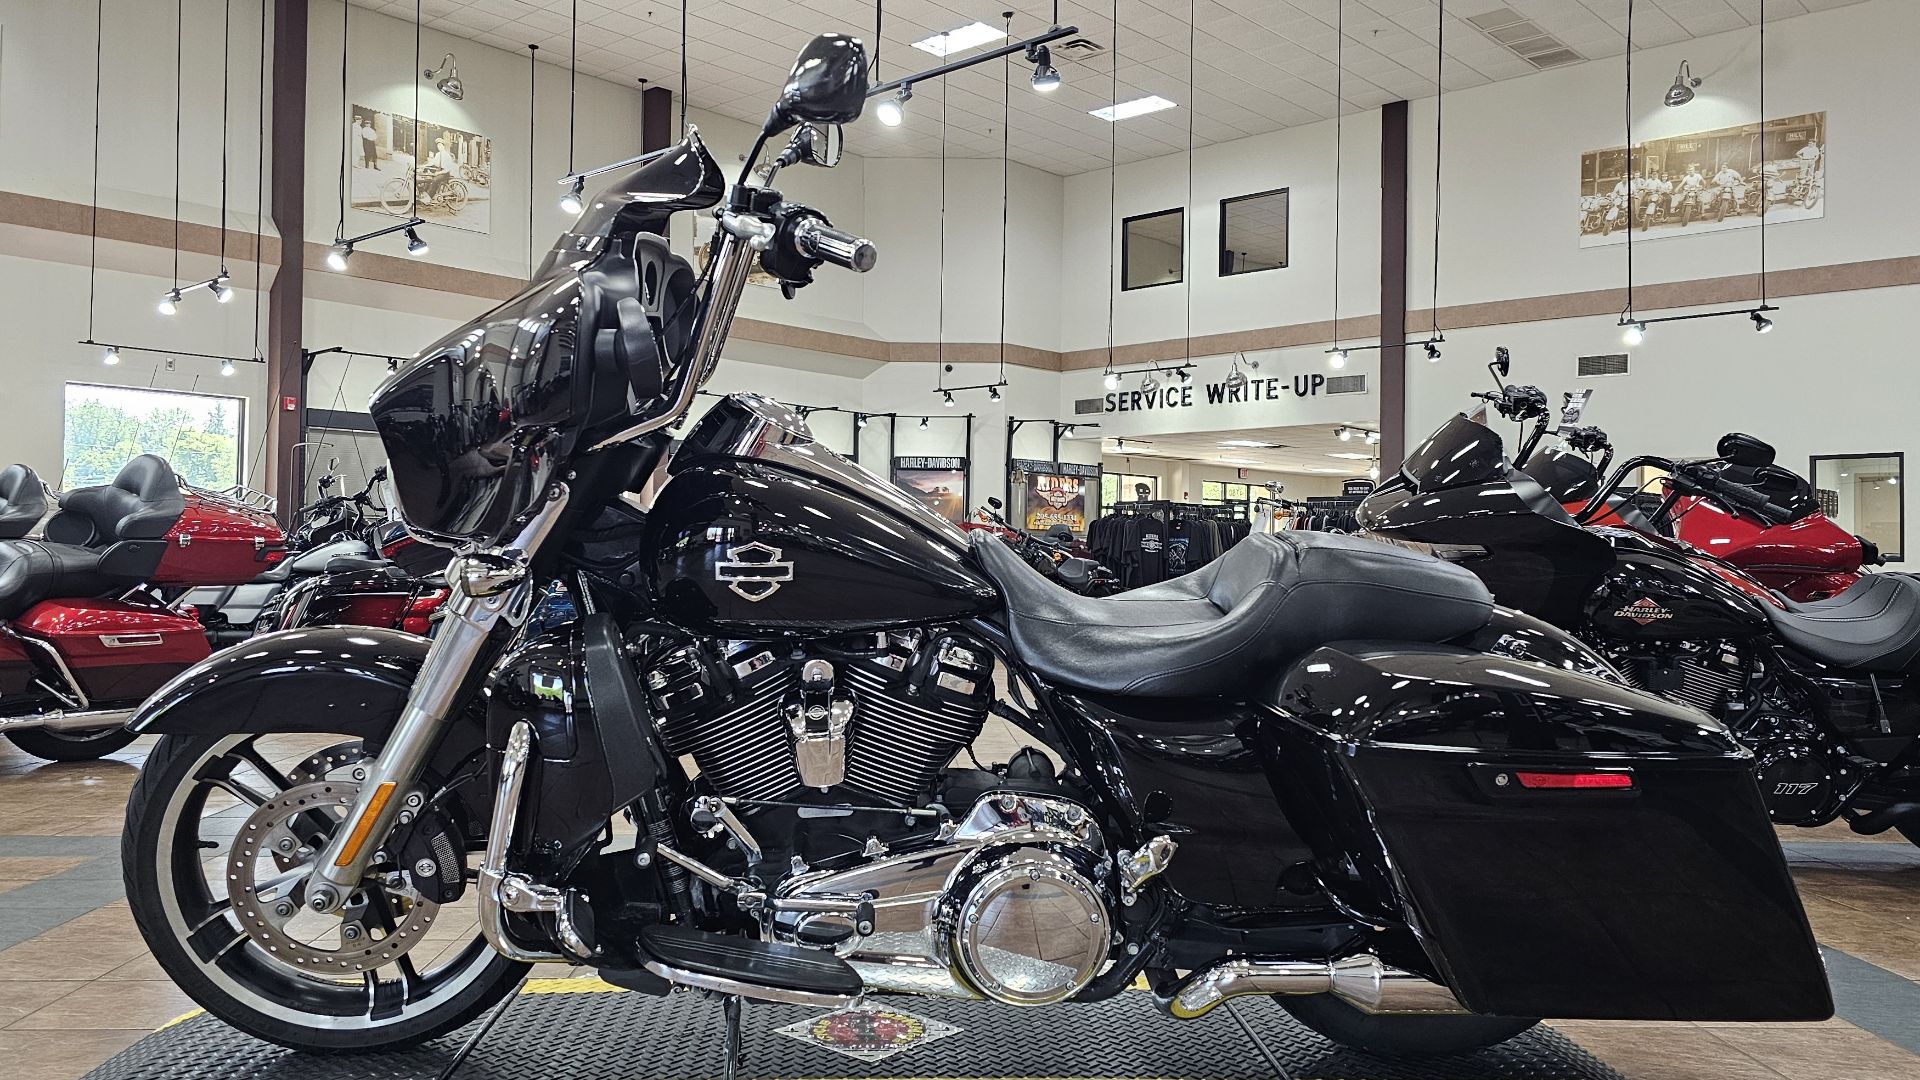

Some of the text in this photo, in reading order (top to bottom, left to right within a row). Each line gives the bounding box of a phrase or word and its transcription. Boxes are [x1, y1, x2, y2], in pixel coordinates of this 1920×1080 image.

[1104, 374, 1325, 412] SERVICE WRITE-UP
[900, 457, 961, 468] HARLEY-DAVIDSON
[1613, 611, 1673, 619] DAVIDSON
[1773, 782, 1819, 795] 117
